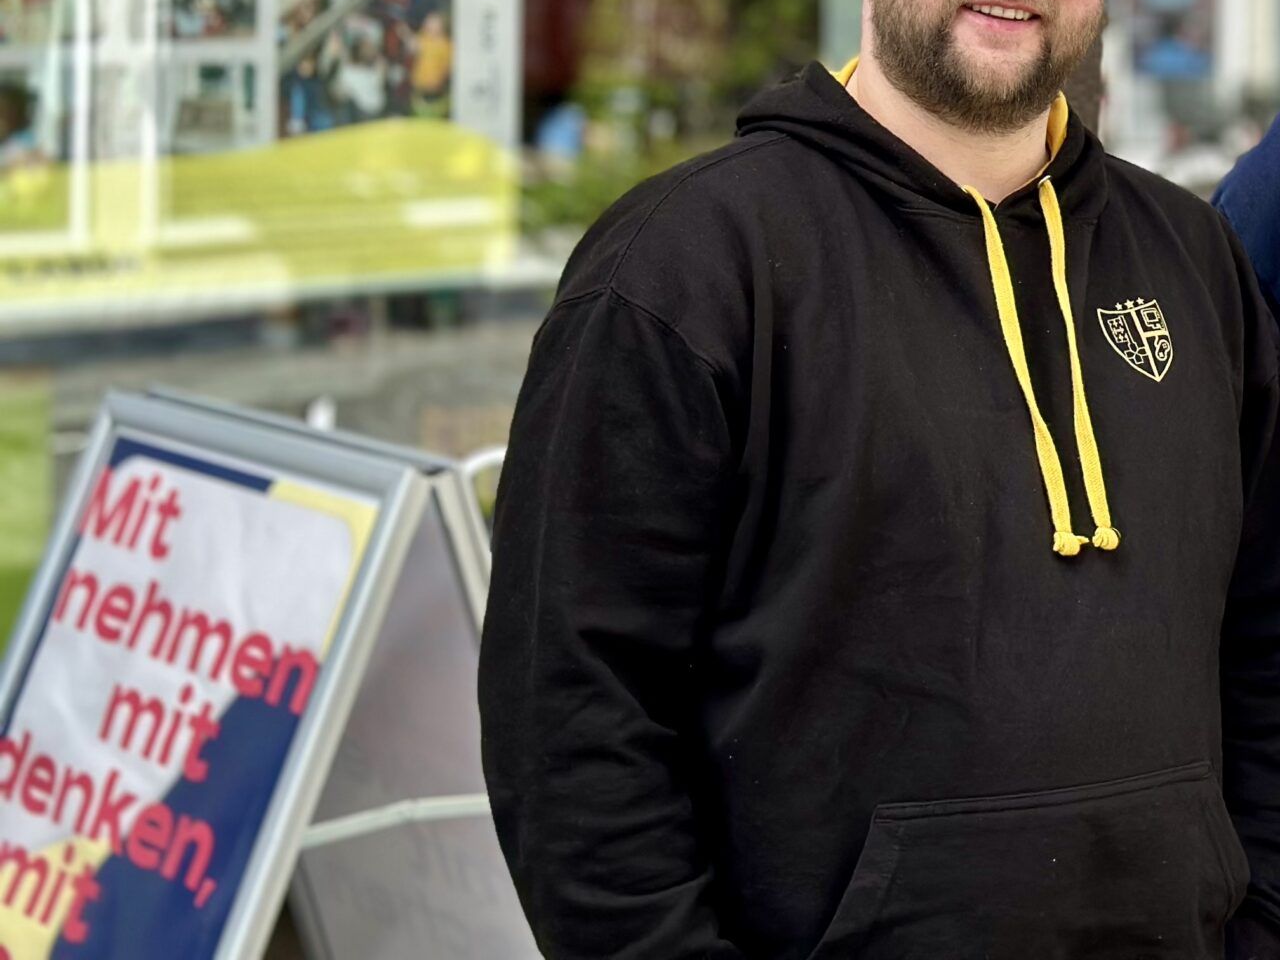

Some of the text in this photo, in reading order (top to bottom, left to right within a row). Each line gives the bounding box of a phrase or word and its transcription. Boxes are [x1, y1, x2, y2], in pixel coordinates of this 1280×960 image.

[78, 465, 184, 562] Mit
[52, 565, 322, 716] nehmen
[101, 683, 221, 783] mit
[0, 730, 217, 909] denken,
[0, 840, 101, 944] mit
